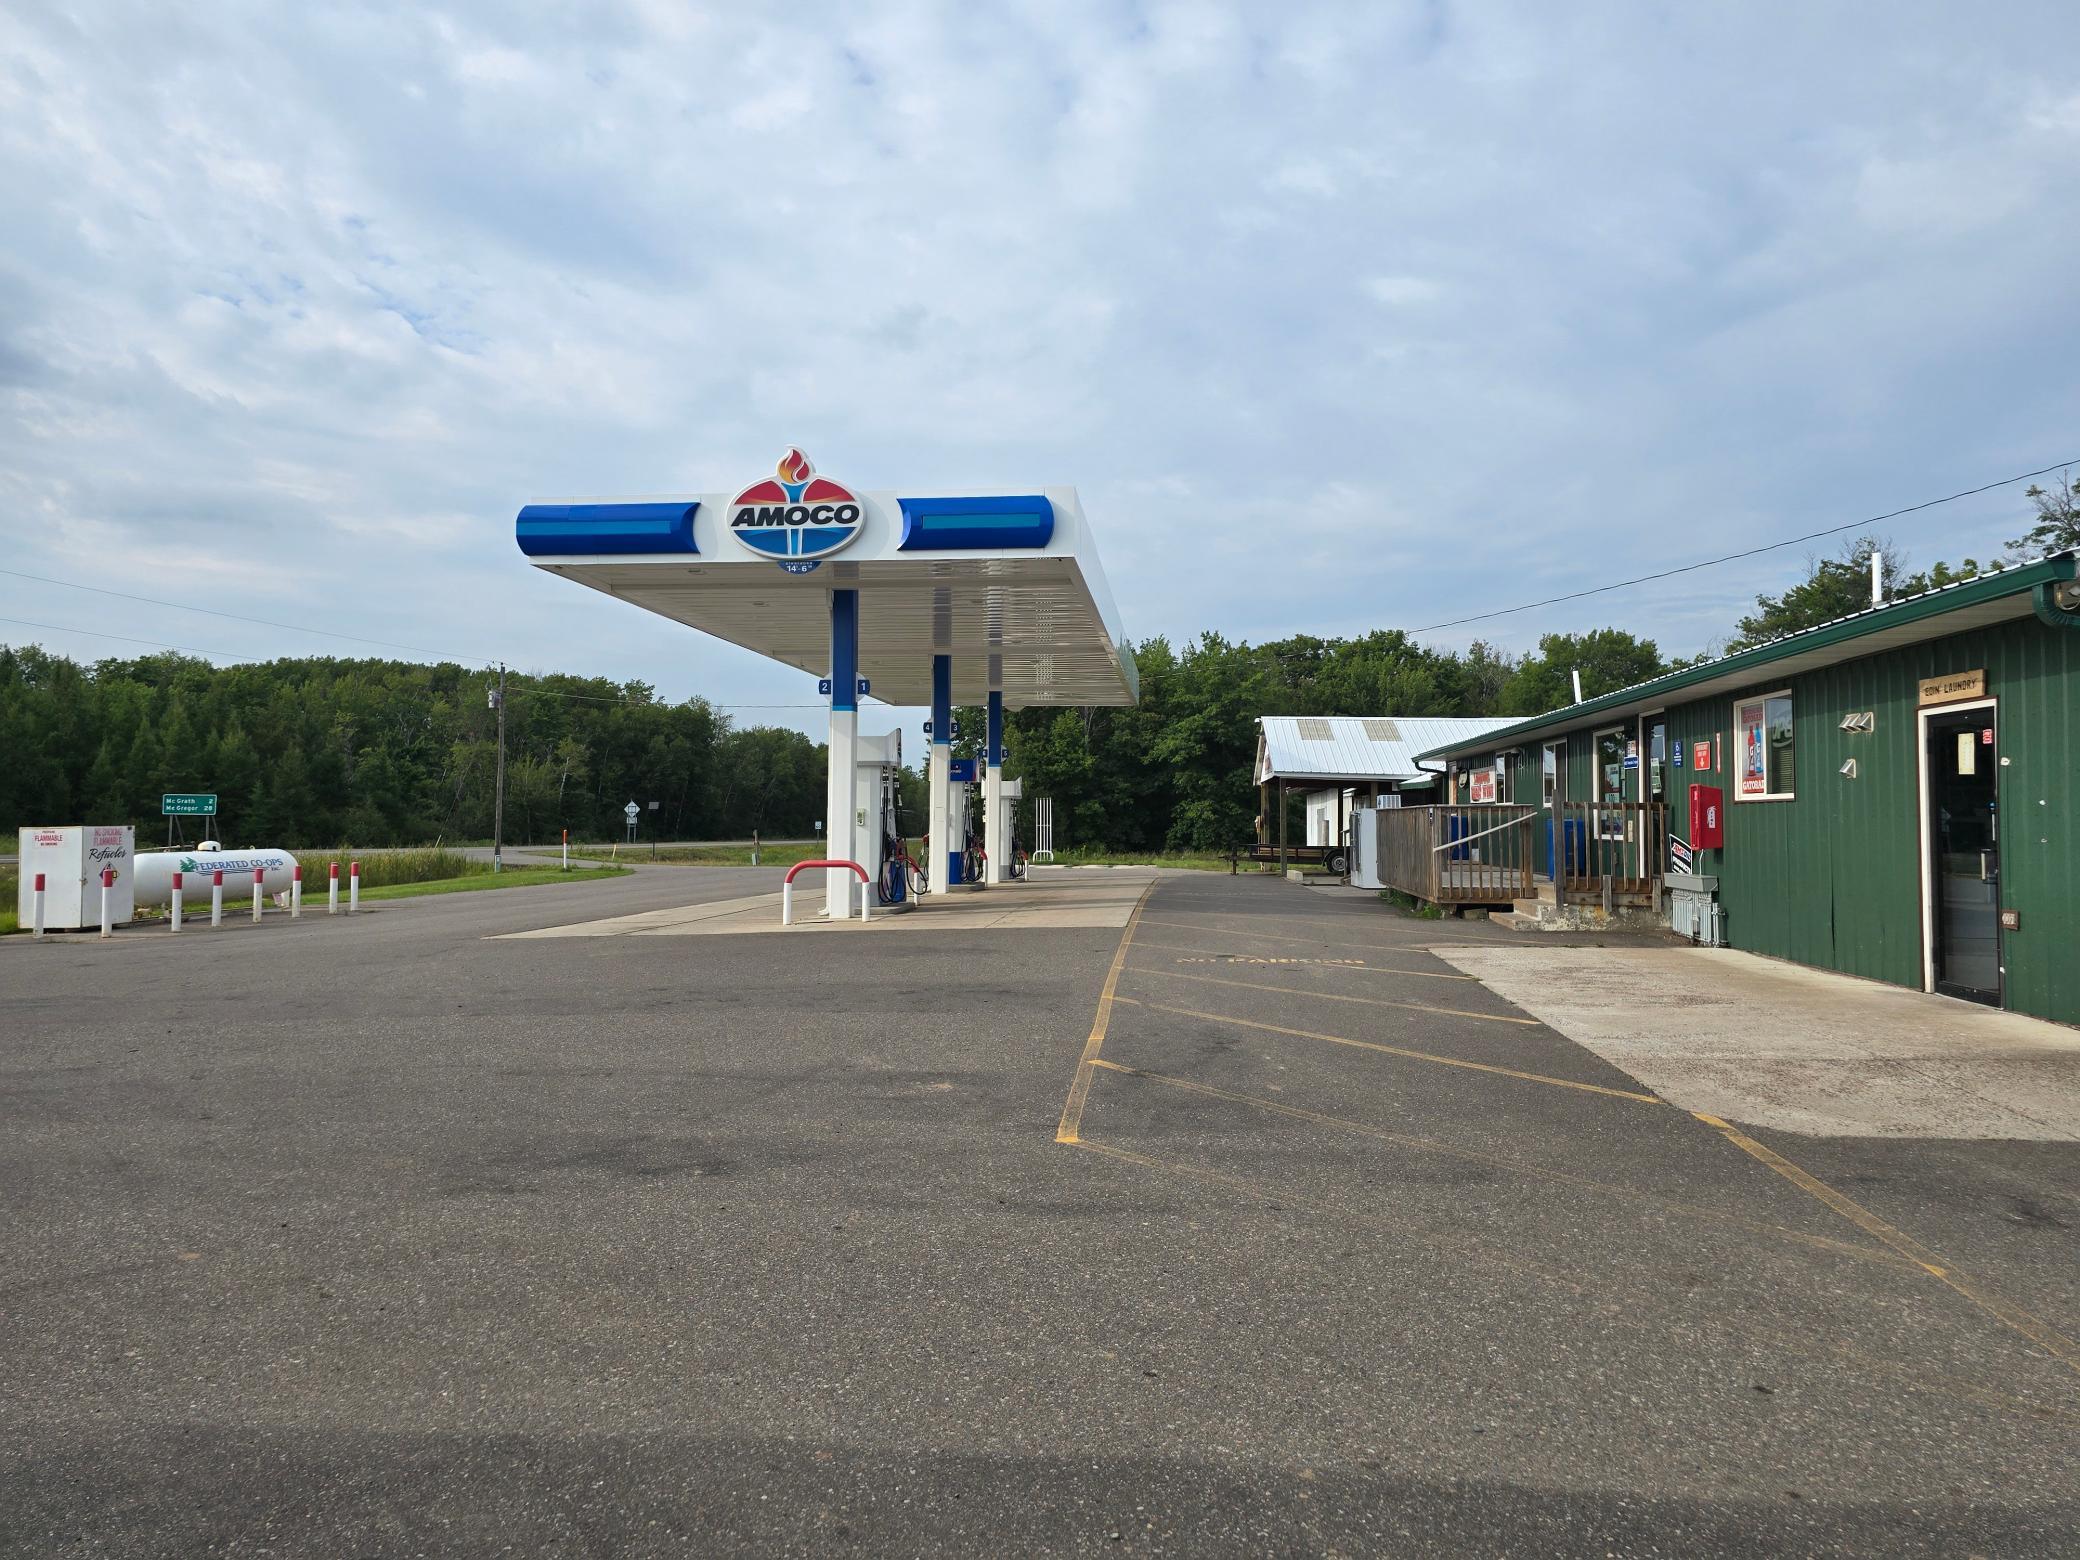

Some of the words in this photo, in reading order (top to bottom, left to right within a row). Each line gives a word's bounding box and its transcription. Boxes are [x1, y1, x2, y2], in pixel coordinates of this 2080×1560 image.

[731, 504, 860, 527] AMOCO
[822, 682, 828, 691] 2
[861, 682, 866, 691] 1
[1944, 679, 1977, 693] LAUNDRY
[35, 834, 63, 842] FLAMMABLE
[94, 836, 123, 846] FLAMMABLE
[195, 860, 249, 871] FEDERATED
[250, 858, 284, 867] CO-OPS
